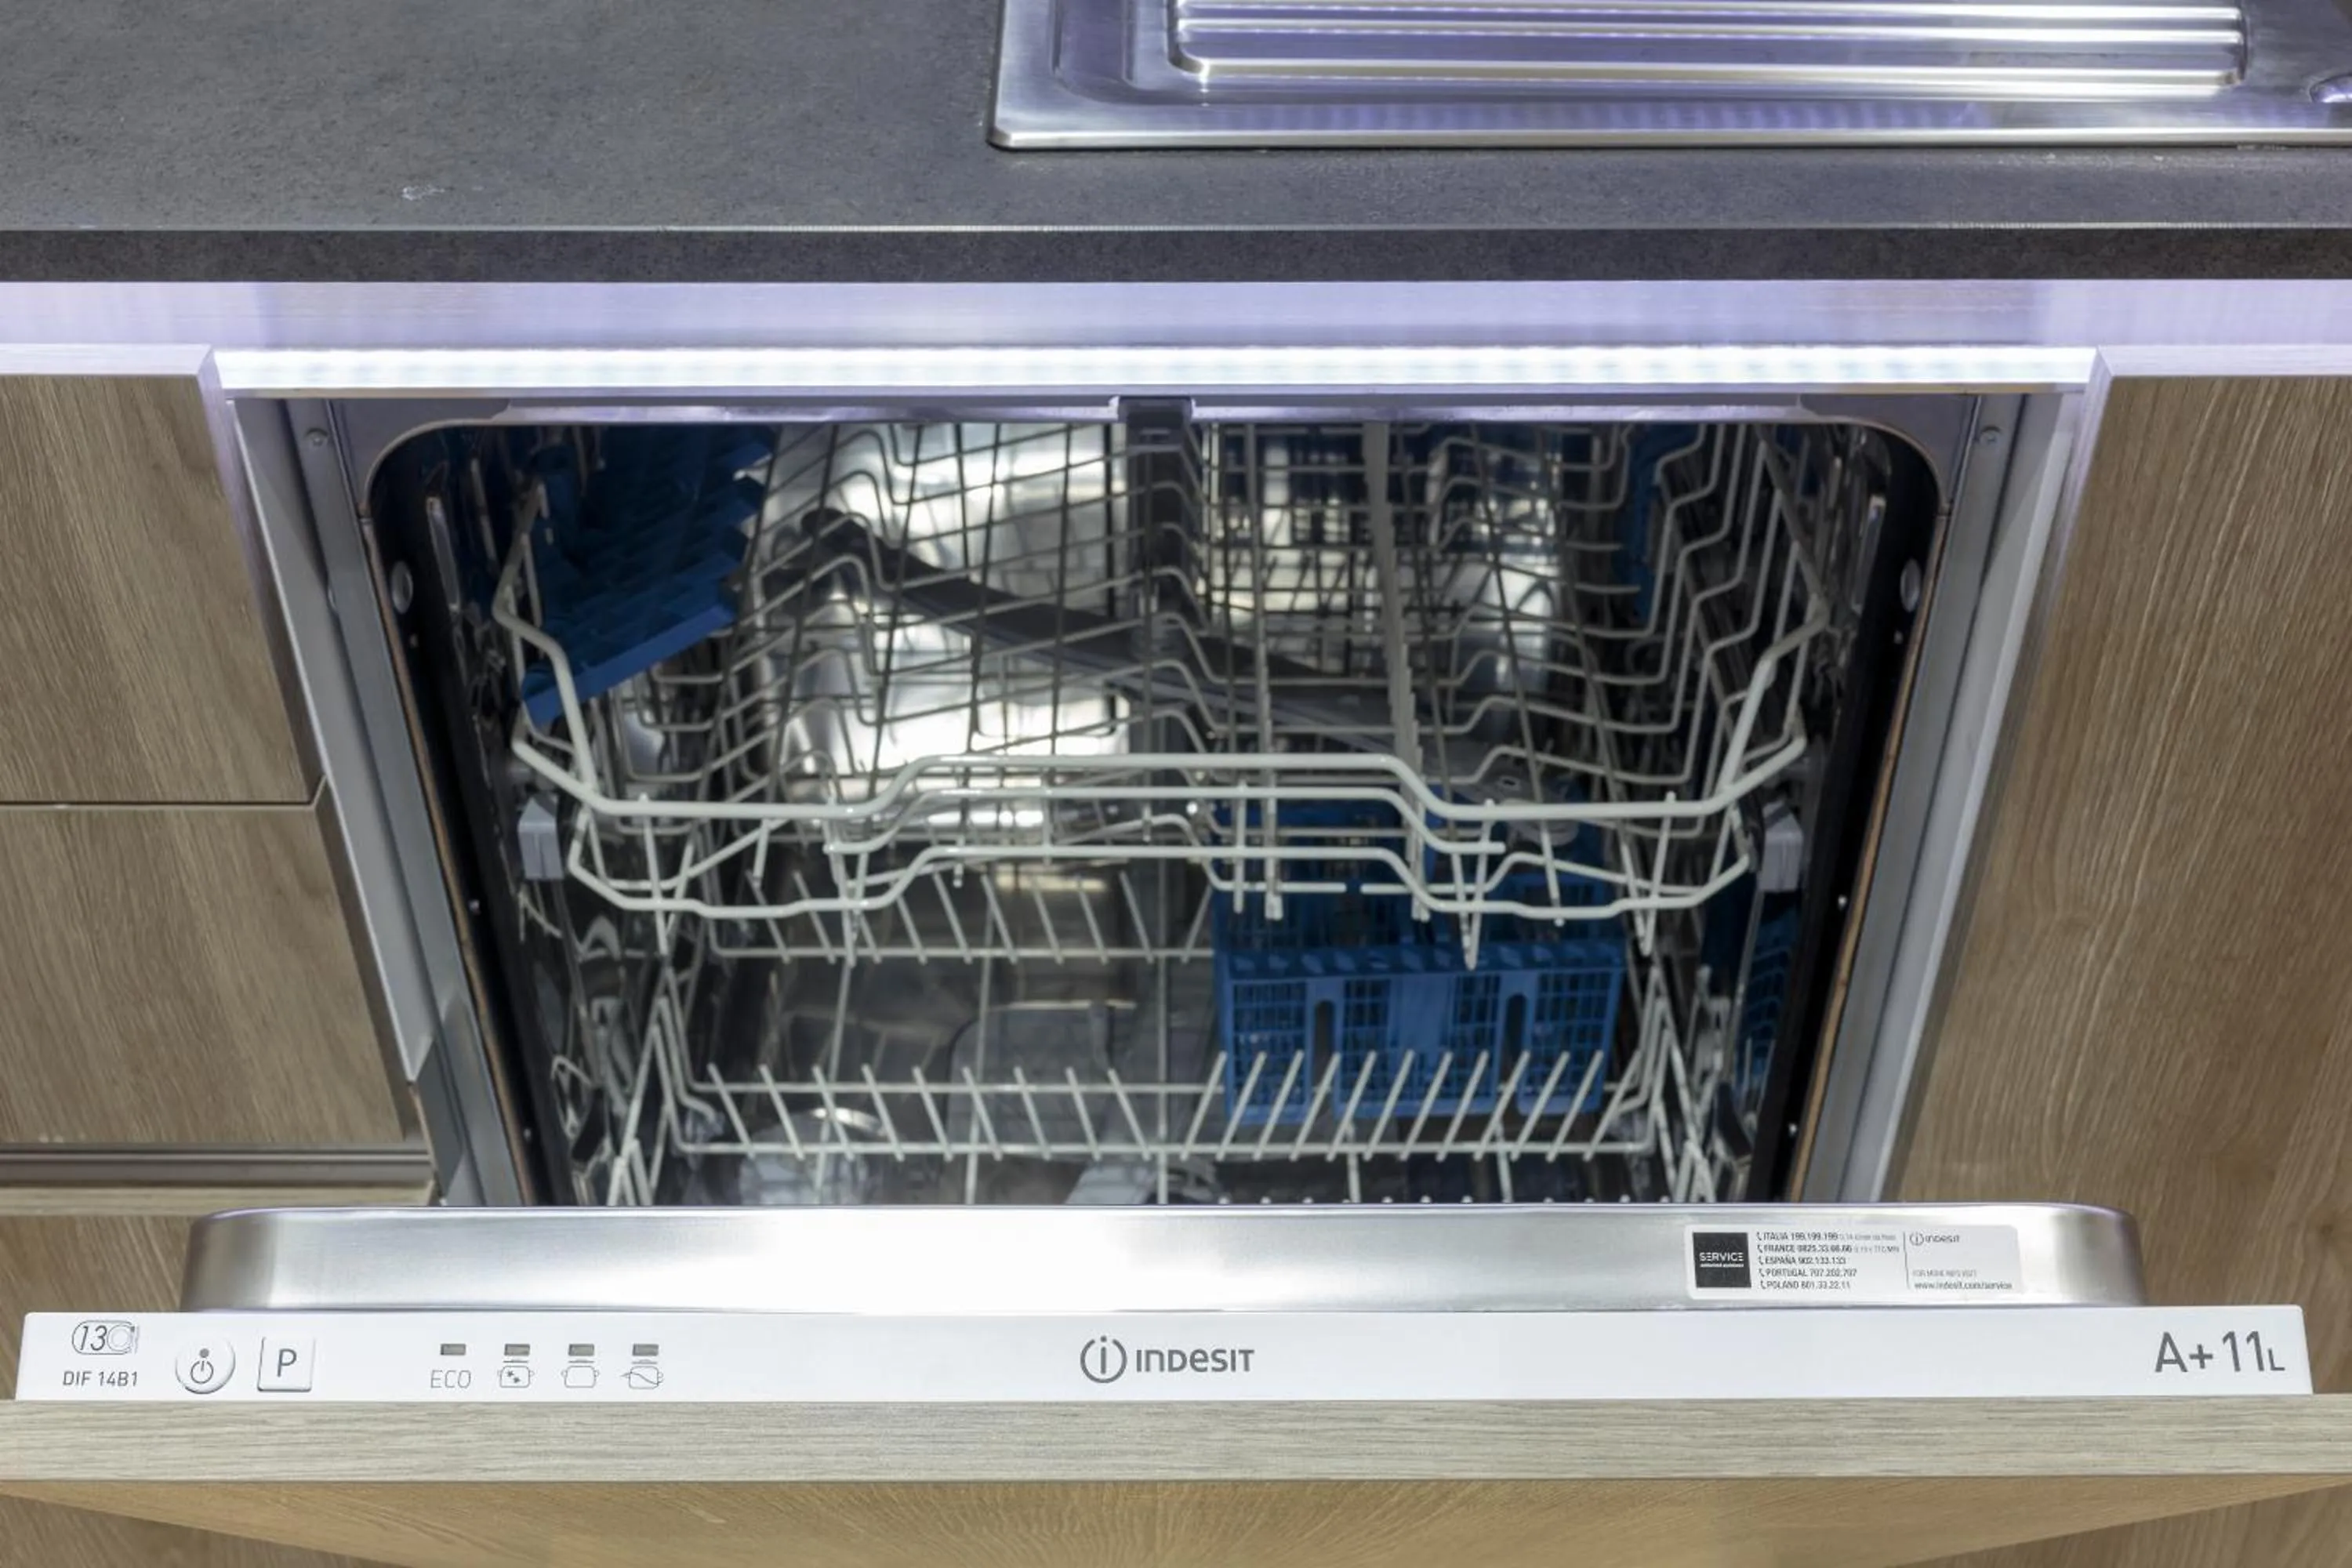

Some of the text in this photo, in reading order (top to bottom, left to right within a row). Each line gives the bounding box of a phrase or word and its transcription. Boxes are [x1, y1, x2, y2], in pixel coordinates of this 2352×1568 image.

[1763, 1232, 1788, 1241] ITALIA
[1699, 1252, 1744, 1261] SERVICE
[277, 1348, 297, 1377] P
[63, 1370, 138, 1387] DIF 14B1
[430, 1370, 471, 1388] ECO
